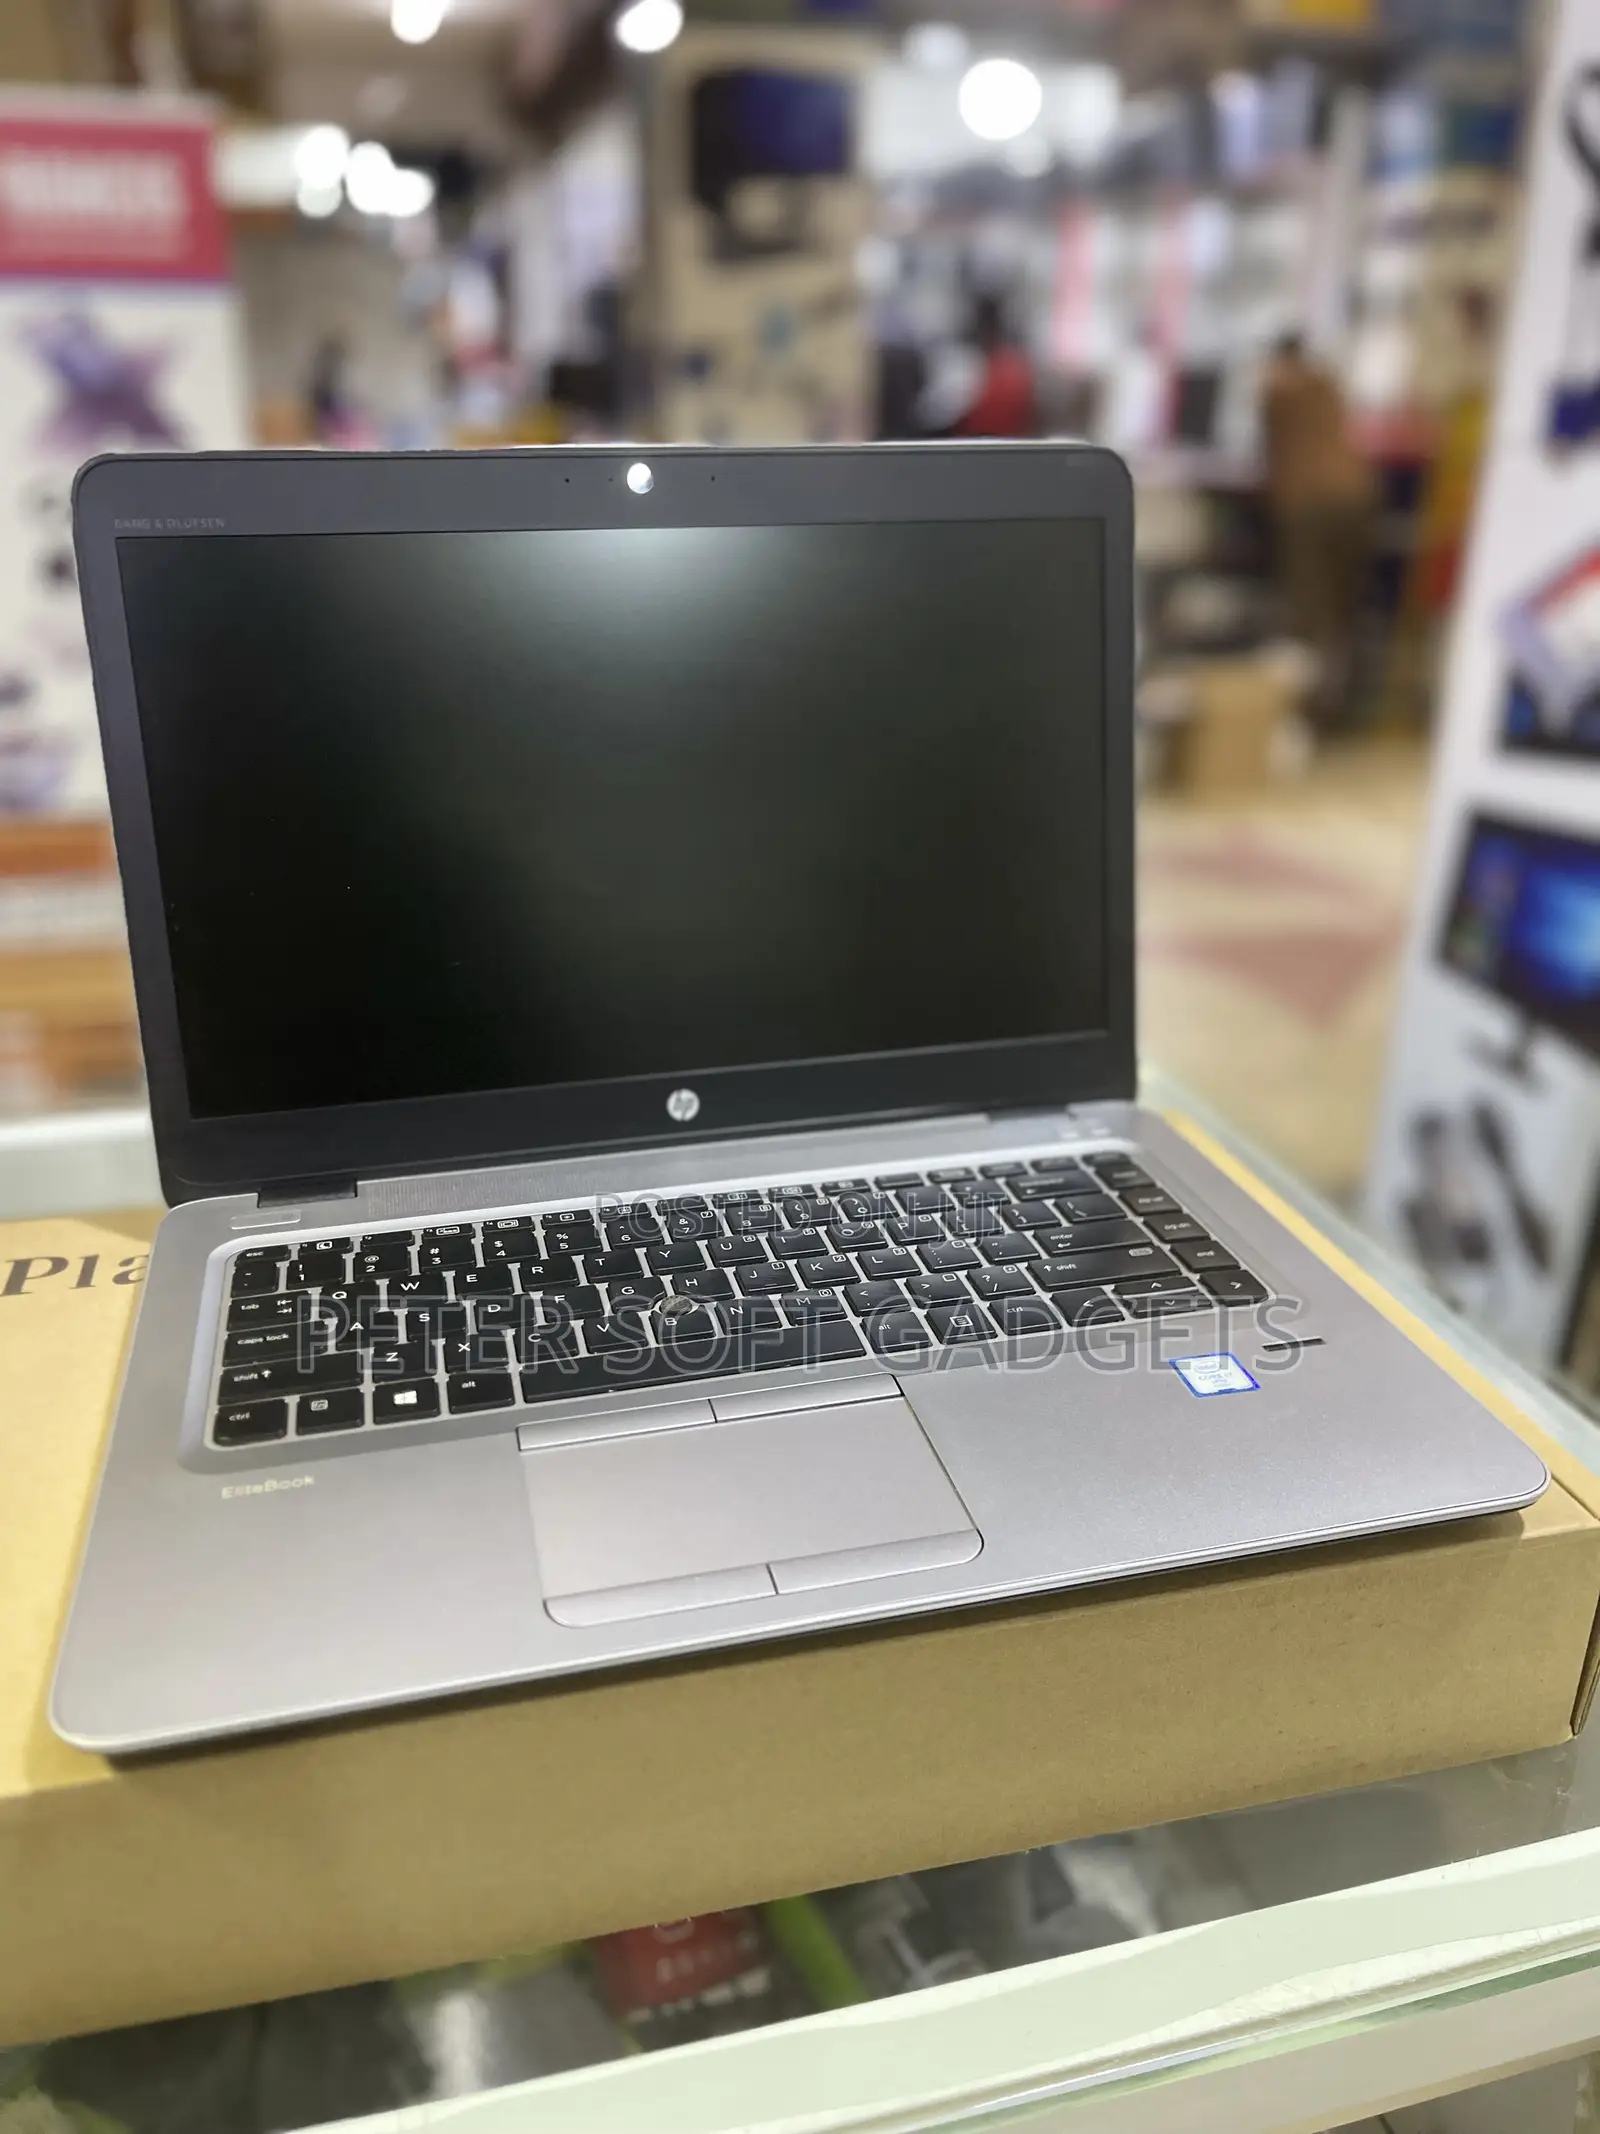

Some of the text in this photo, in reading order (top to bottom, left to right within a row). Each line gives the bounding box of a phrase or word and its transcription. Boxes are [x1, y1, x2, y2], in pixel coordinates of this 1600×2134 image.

[679, 1218, 689, 1226] &
[898, 1222, 908, 1230] P
[841, 1228, 854, 1236] O
[494, 1240, 503, 1248] $
[720, 1243, 733, 1251] U
[659, 1250, 671, 1258] Y
[364, 1255, 379, 1263] @
[431, 1257, 441, 1265] 3
[595, 1258, 606, 1266] T
[532, 1266, 544, 1274] R
[811, 1263, 823, 1271] K
[1056, 1263, 1078, 1271] shift
[467, 1274, 478, 1282] E
[750, 1270, 758, 1278] J
[401, 1282, 420, 1291] W
[685, 1278, 698, 1287] H
[621, 1286, 635, 1295] G
[332, 1291, 348, 1301] Q
[555, 1295, 566, 1303] F
[796, 1296, 812, 1306] M
[241, 1303, 259, 1311] tab
[488, 1304, 501, 1313] D
[730, 1306, 743, 1315] N
[1006, 1306, 1024, 1314] ctrl
[419, 1313, 430, 1322] S
[665, 1317, 677, 1326] B
[350, 1322, 364, 1331] A
[597, 1323, 610, 1333] V
[237, 1333, 289, 1346] caps lock
[528, 1334, 541, 1342] C
[458, 1343, 471, 1352] X
[386, 1352, 398, 1362] Z
[234, 1372, 258, 1382] shift
[229, 1412, 251, 1421] ctrl
[221, 1475, 315, 1499] EliteBook
